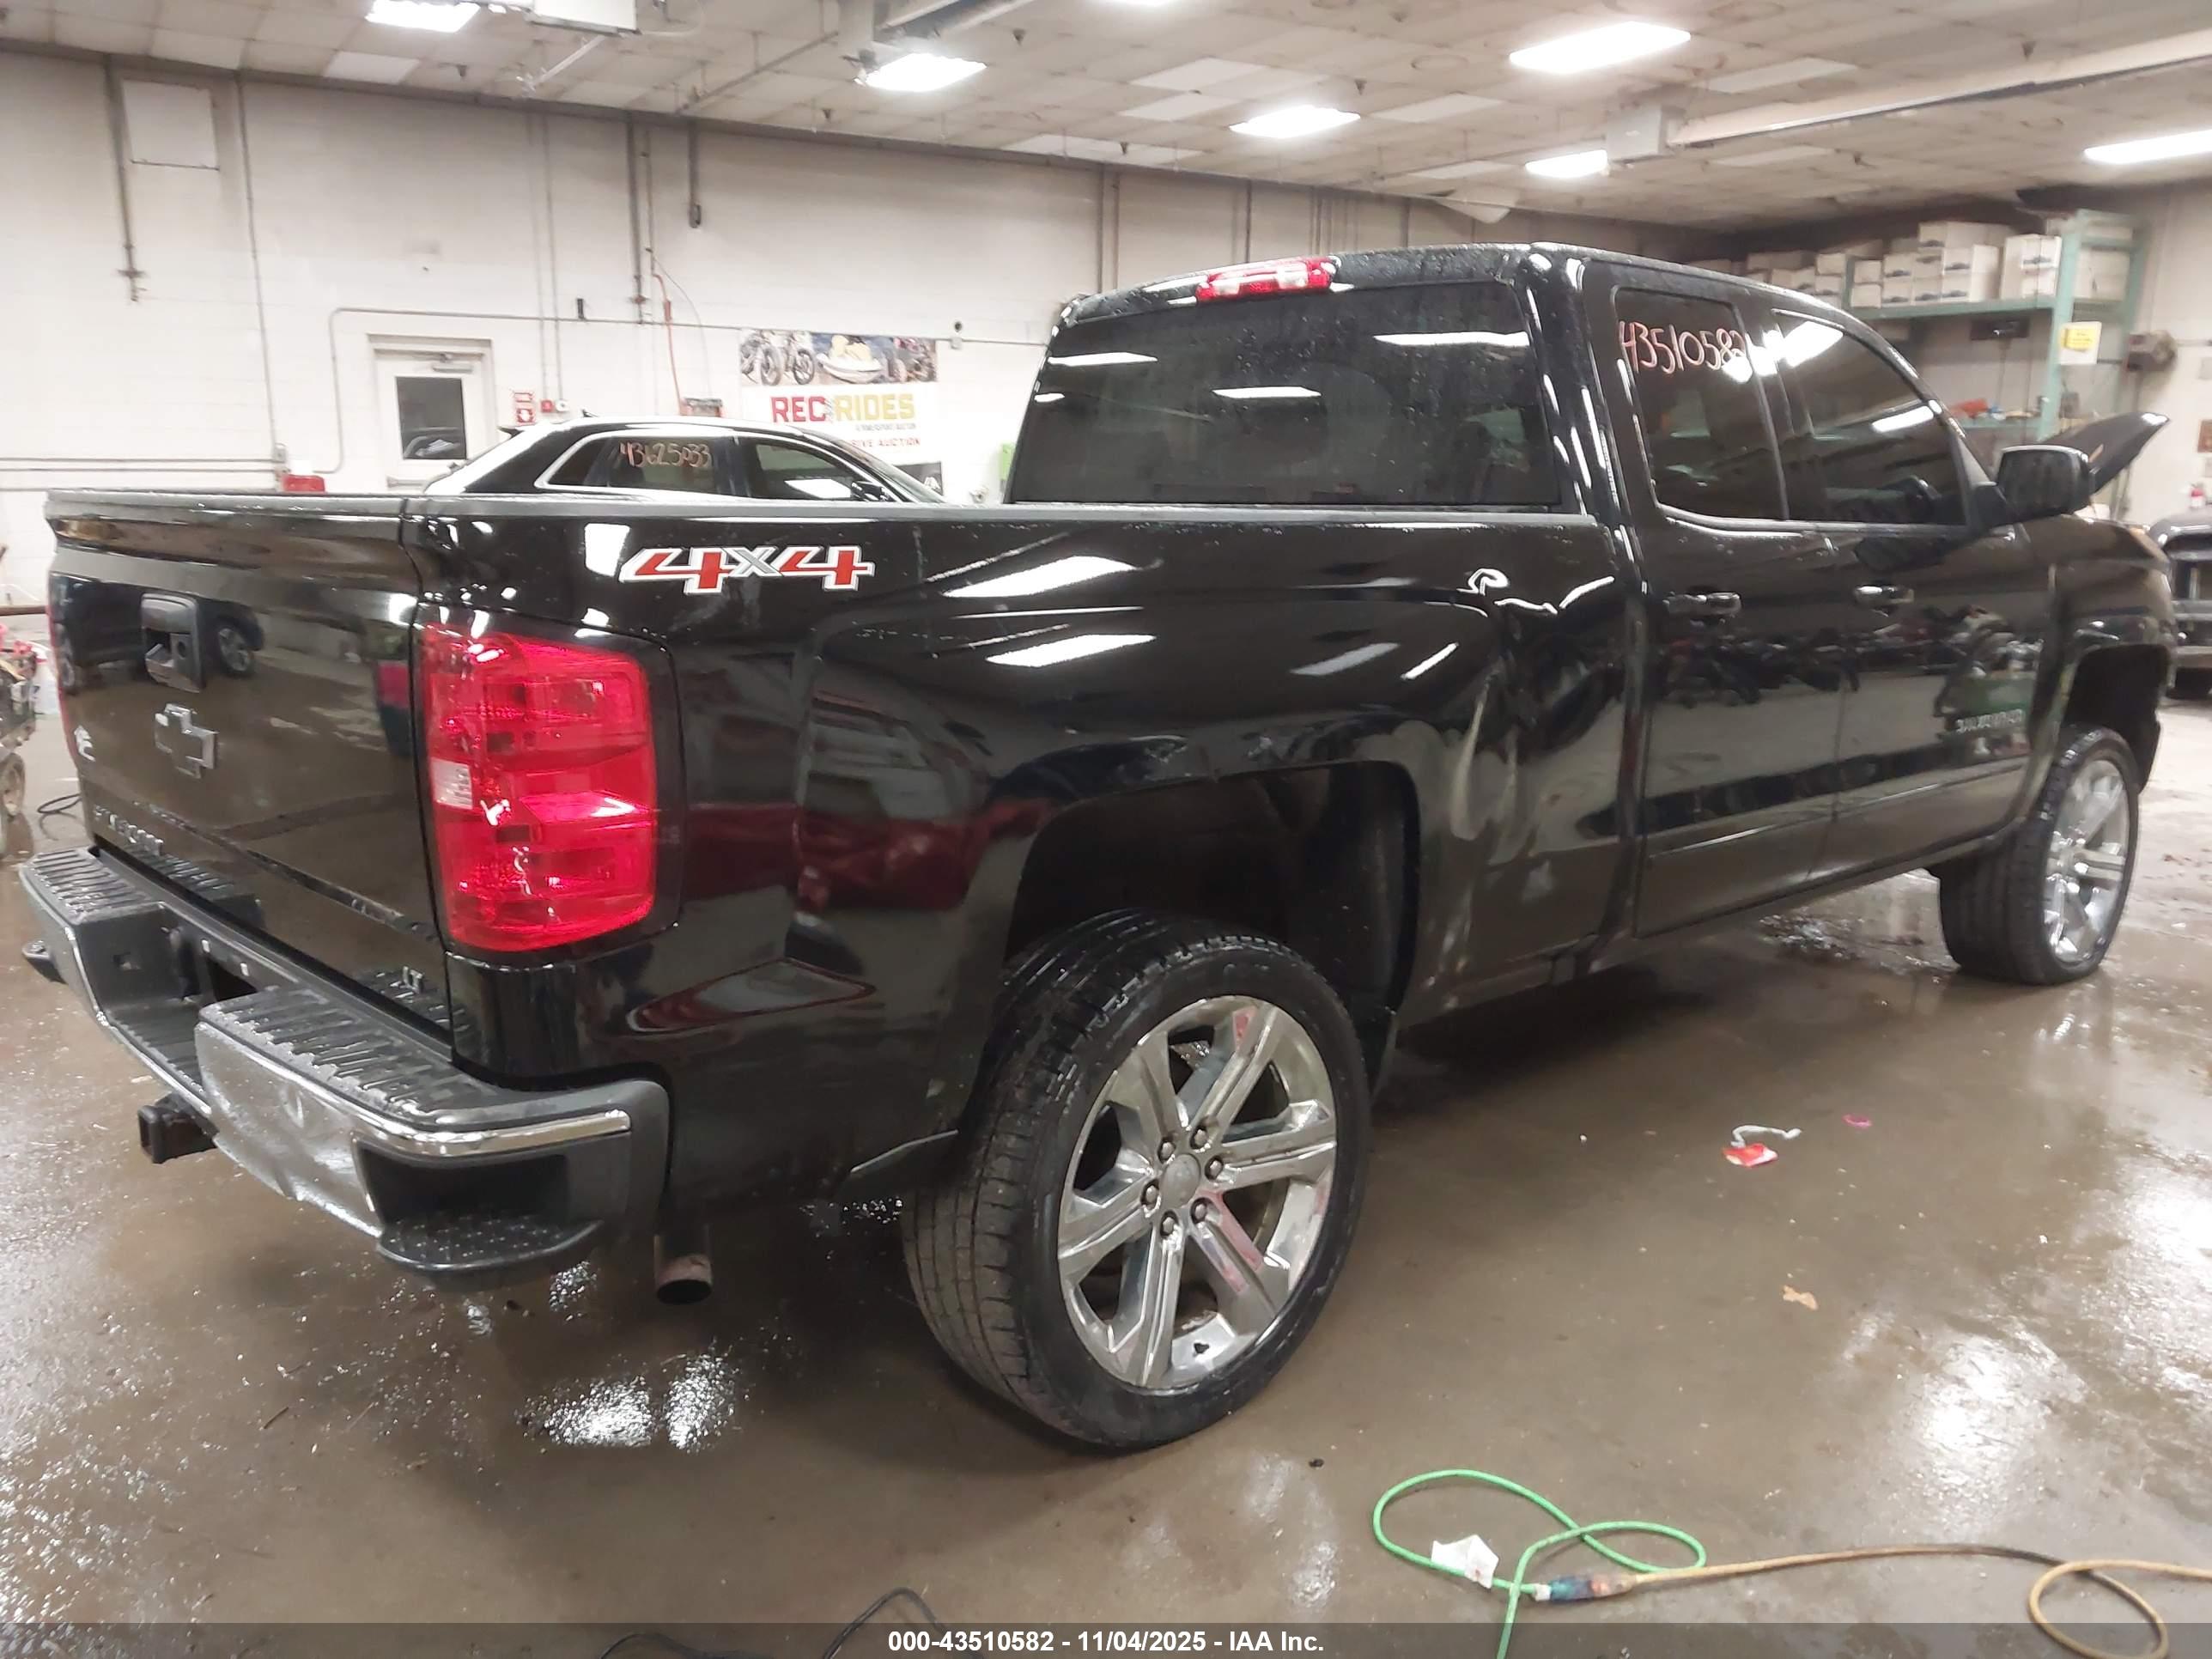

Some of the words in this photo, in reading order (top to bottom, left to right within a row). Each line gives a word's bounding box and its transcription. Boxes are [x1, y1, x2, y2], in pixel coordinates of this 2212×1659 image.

[1619, 320, 1747, 374] 43510582
[771, 396, 826, 422] REC
[834, 393, 915, 422] RIDES
